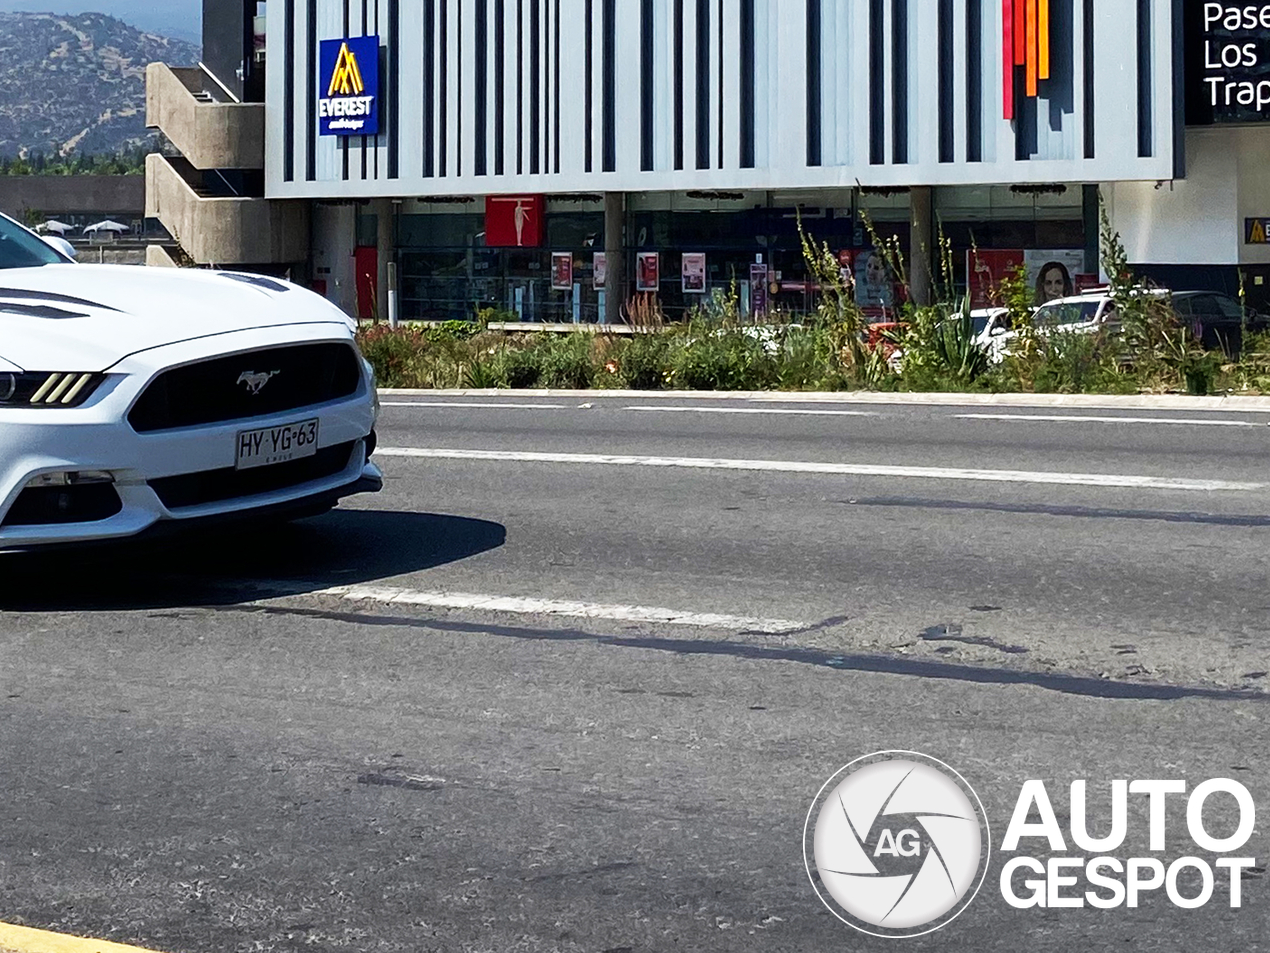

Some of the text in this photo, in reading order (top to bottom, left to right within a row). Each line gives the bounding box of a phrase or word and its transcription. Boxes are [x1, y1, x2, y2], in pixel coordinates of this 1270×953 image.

[1204, 2, 1270, 32] Pase
[1205, 40, 1257, 68] Los
[319, 96, 374, 117] EVEREST
[1203, 76, 1270, 111] Trap
